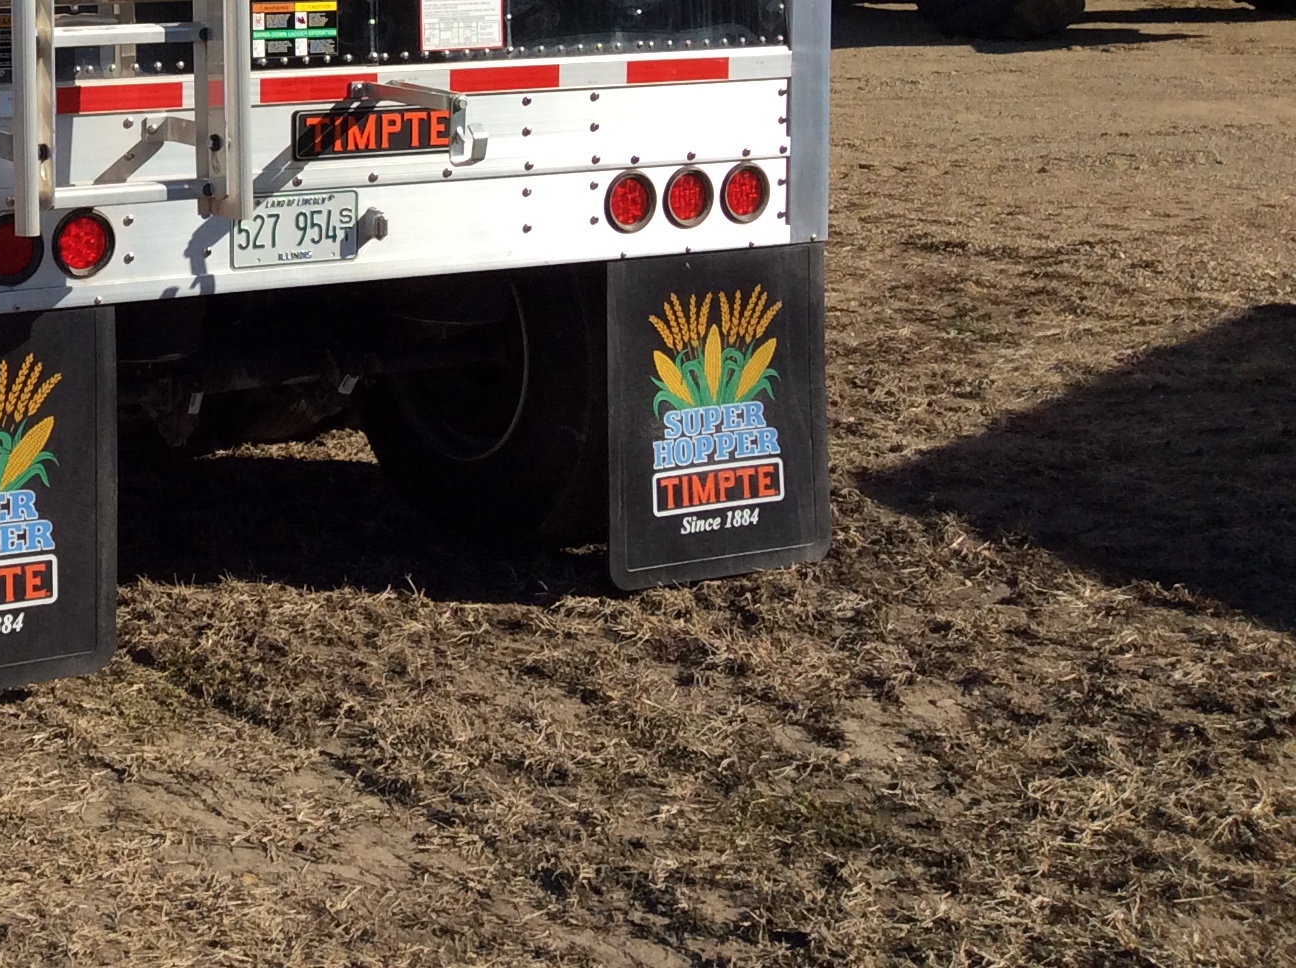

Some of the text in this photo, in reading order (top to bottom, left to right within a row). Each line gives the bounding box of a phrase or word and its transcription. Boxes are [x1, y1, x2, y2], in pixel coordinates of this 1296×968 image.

[305, 109, 450, 153] TIMPTE
[265, 196, 326, 209] LAND OF LINCOLN
[237, 213, 280, 250] 527
[295, 208, 338, 247] 954
[278, 250, 313, 261] ILLINOIS
[664, 401, 767, 439] SUPER
[653, 427, 781, 470] HOPPER
[660, 465, 777, 509] TIMPTE
[681, 507, 760, 535] Since 1884
